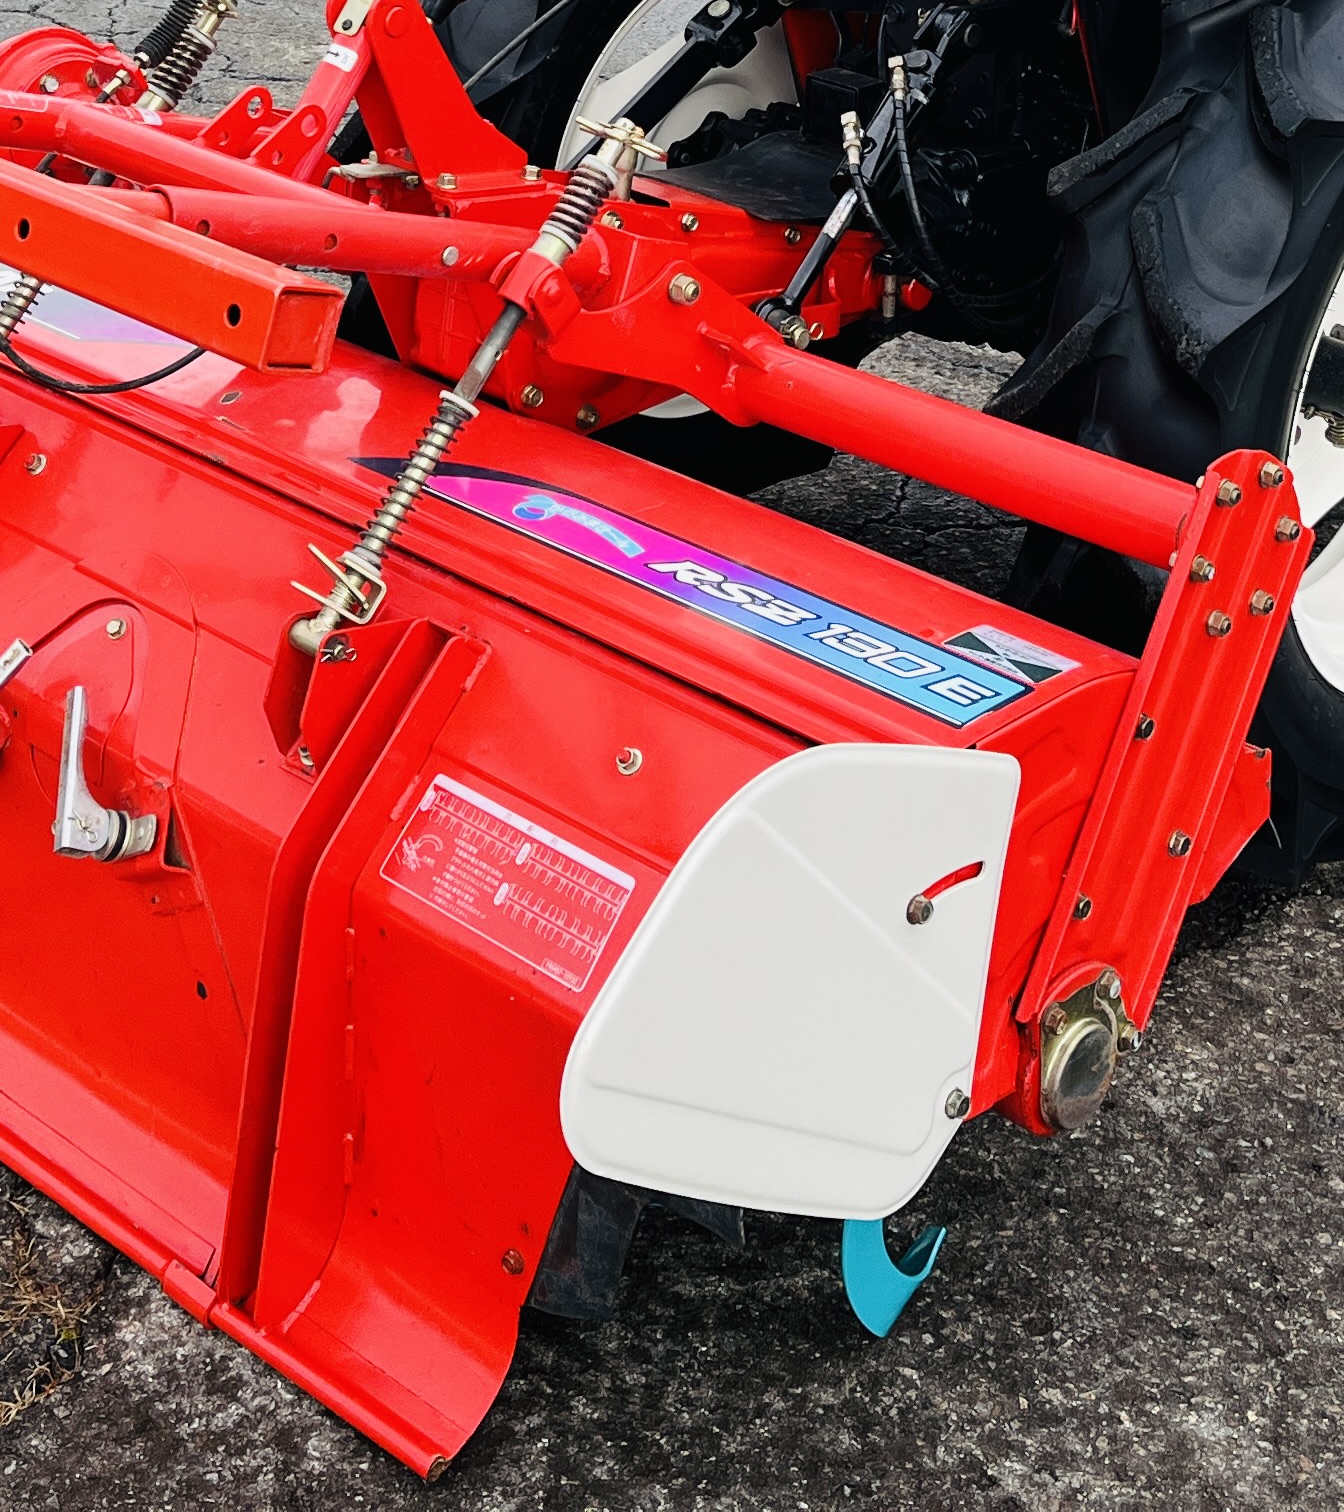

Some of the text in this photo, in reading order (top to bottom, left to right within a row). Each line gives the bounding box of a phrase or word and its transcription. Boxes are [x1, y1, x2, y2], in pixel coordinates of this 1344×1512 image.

[644, 559, 822, 627] RSZ
[805, 622, 946, 679] 130
[921, 674, 1002, 708] E
